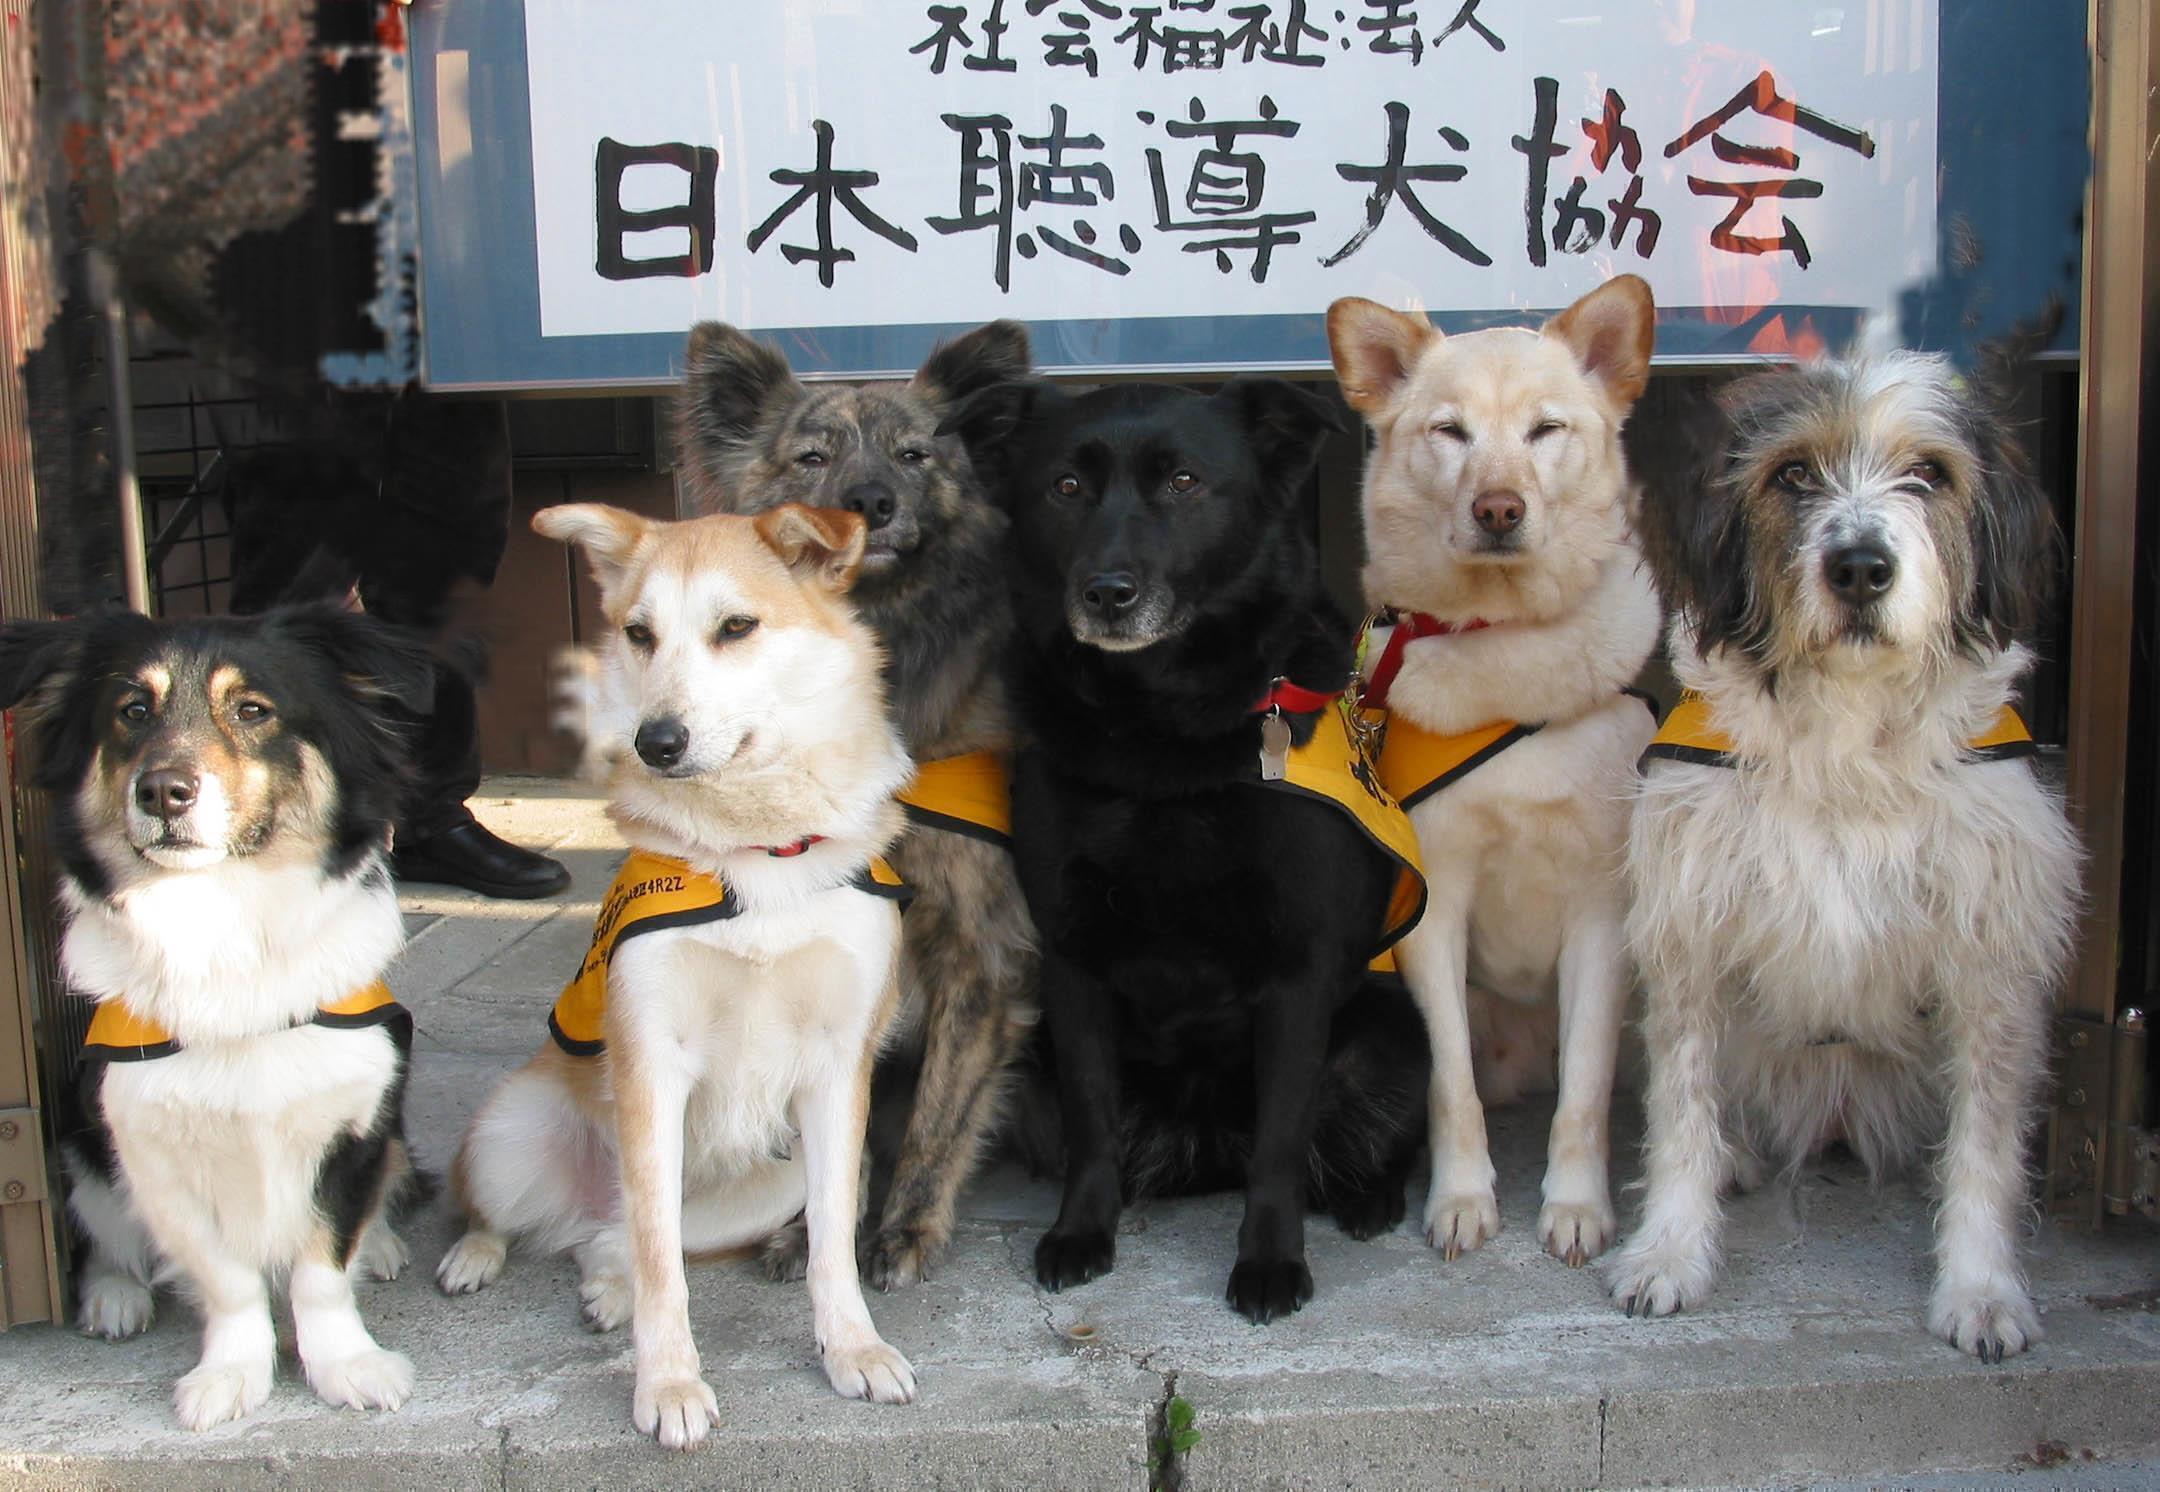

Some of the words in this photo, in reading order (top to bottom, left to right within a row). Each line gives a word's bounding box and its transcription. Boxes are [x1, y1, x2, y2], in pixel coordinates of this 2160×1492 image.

[907, 0, 1506, 78] 社会福祉法人
[594, 71, 1876, 293] 日本聴導犬協会
